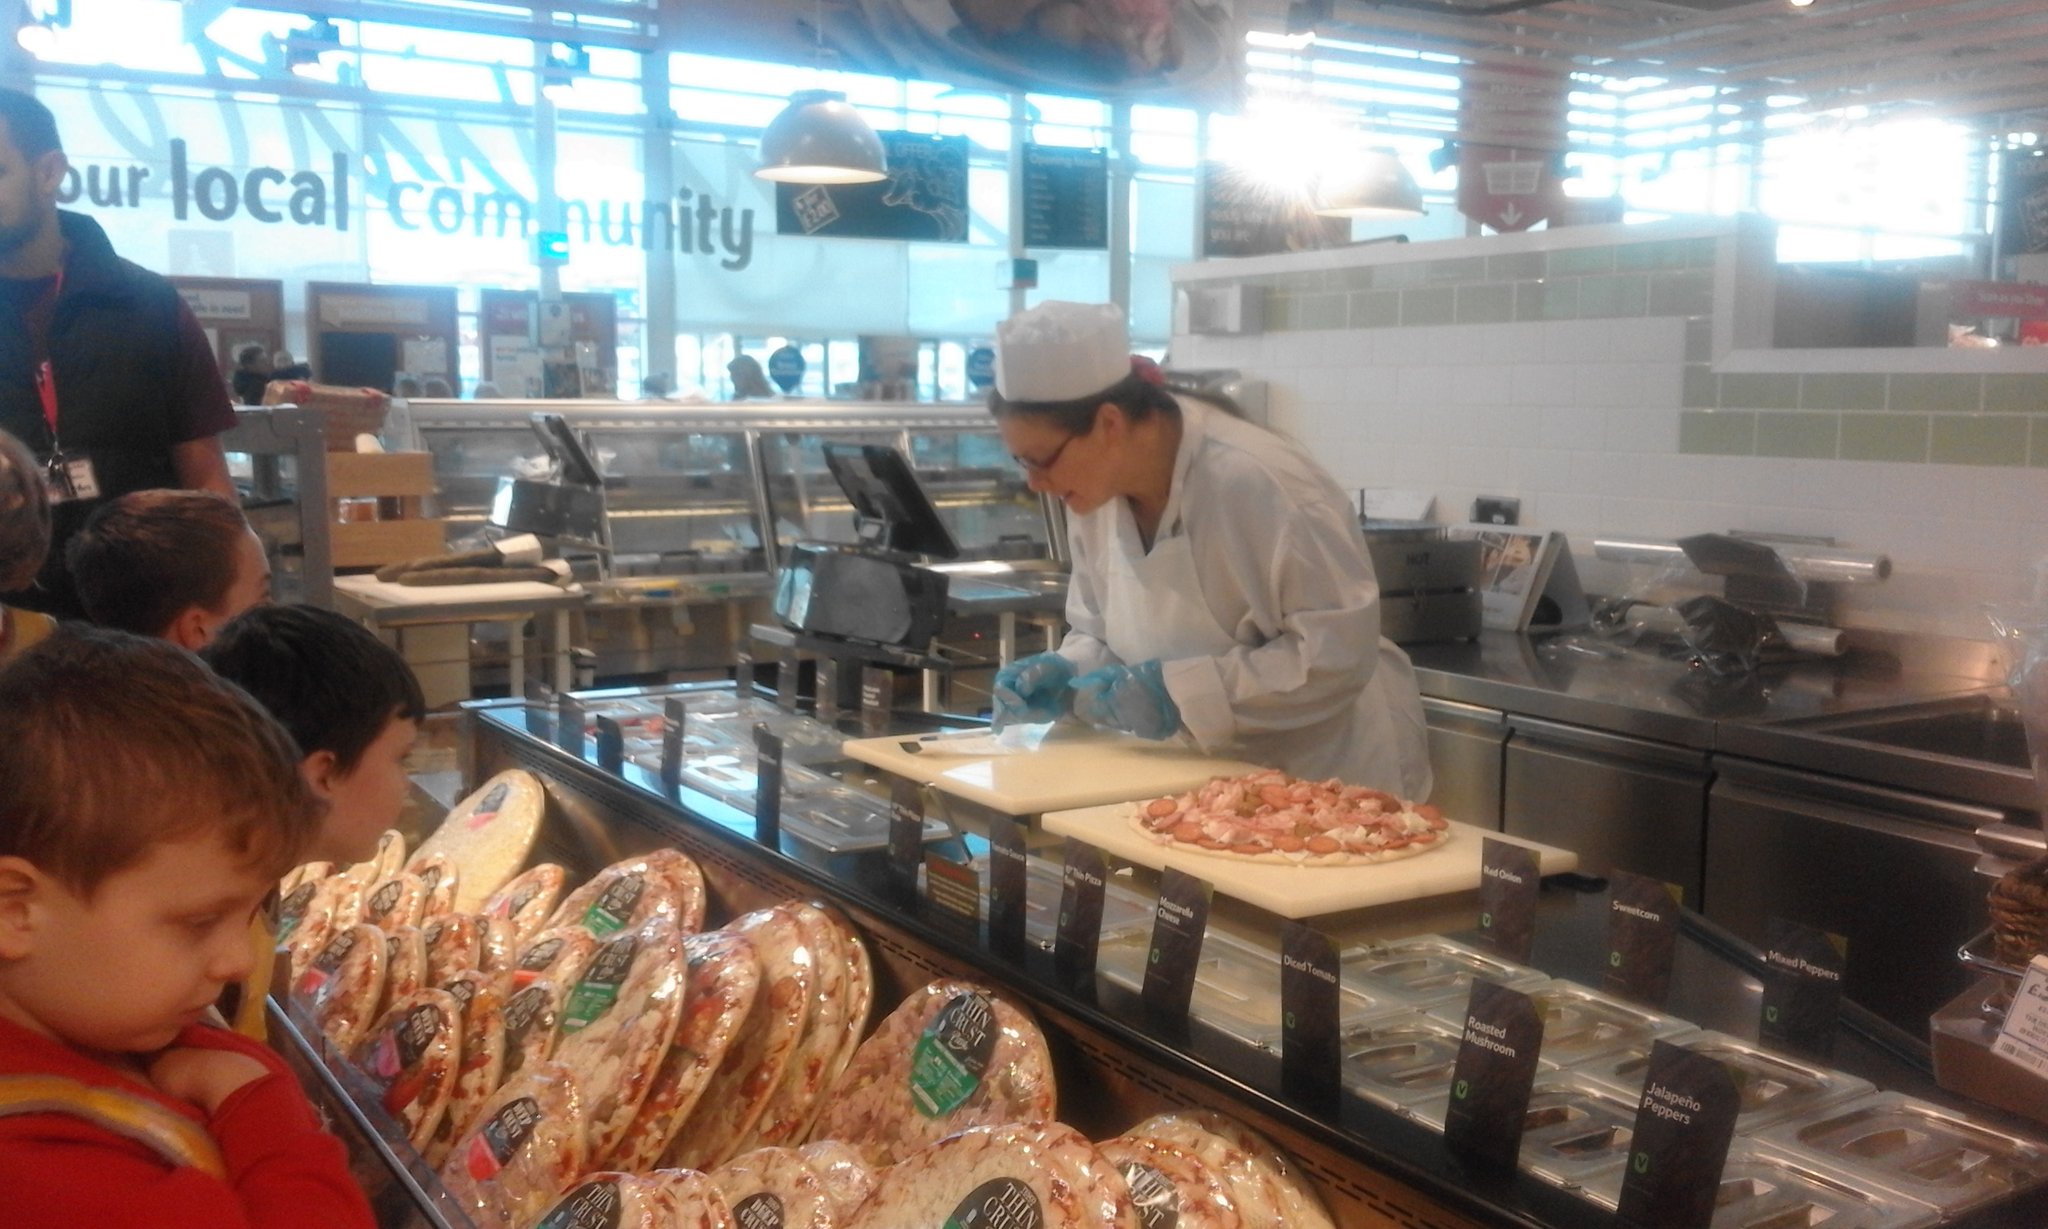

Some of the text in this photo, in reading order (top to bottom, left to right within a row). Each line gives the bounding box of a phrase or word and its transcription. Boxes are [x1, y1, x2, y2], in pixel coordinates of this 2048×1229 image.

[170, 137, 349, 231] local
[1085, 872, 1102, 886] Pizza
[1483, 865, 1522, 884] Red Onion
[1158, 907, 1180, 926] Cheese
[1160, 896, 1194, 919] Mozzarella
[1612, 900, 1660, 922] Sweetcorn
[1284, 954, 1337, 984] Diced Tomato
[1769, 950, 1839, 981] Mixed Peppers
[950, 1008, 986, 1047] CRUST
[961, 998, 991, 1029] THIN
[1468, 1015, 1507, 1039] Roasted
[1465, 1030, 1516, 1058] Mushroom
[1643, 1096, 1691, 1125] Peppers
[1647, 1082, 1702, 1112] Jalapeño
[570, 1196, 608, 1229] CRUST
[586, 1183, 616, 1214] THIN
[750, 1198, 779, 1227] DEEP
[1000, 1182, 1040, 1229] THIN
